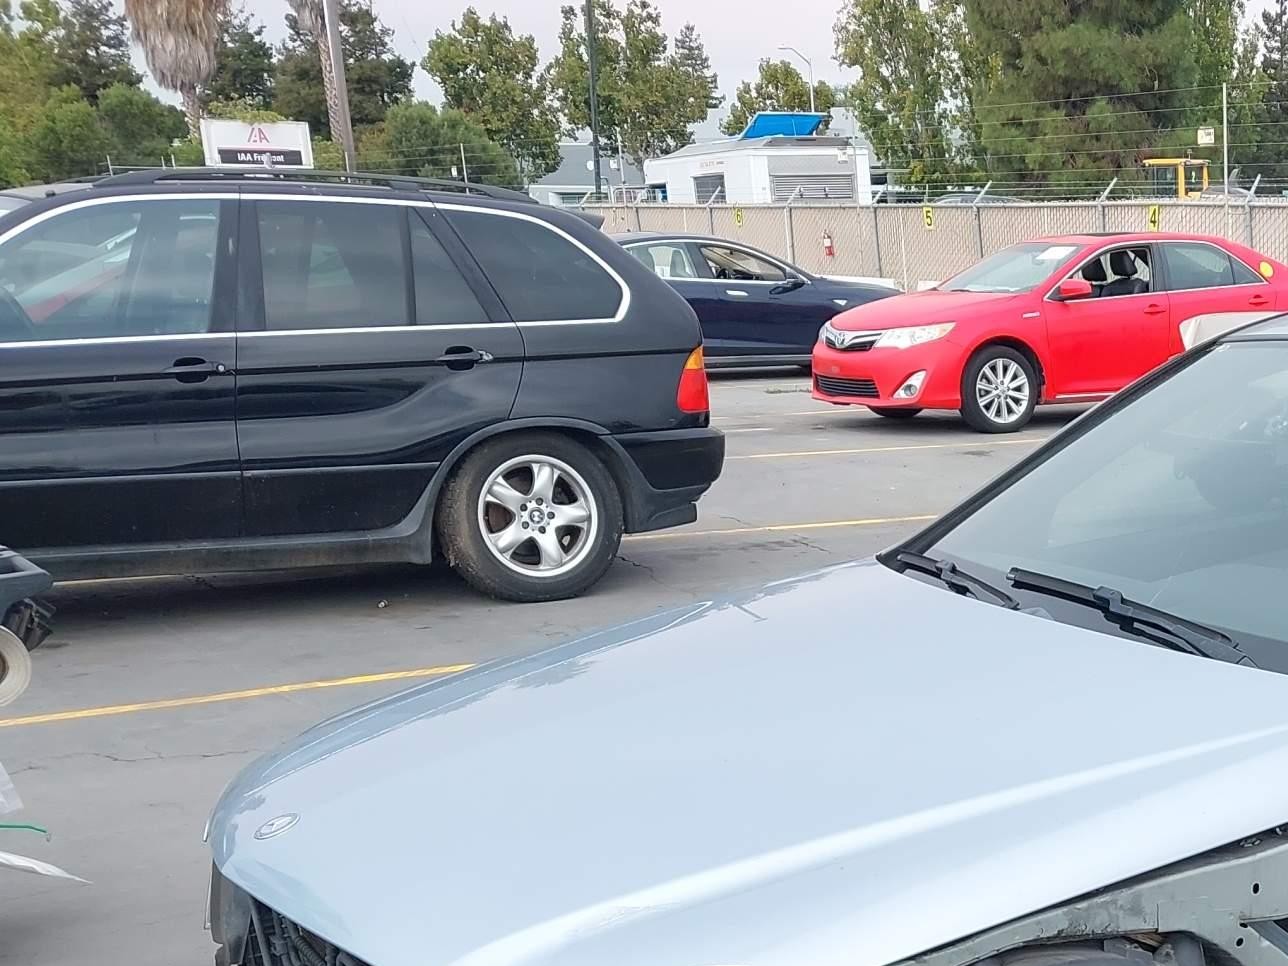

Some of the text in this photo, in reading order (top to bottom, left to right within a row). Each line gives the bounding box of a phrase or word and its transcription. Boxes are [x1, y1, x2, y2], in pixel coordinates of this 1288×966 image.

[237, 152, 254, 162] IAA
[925, 209, 933, 226] 5
[1150, 207, 1157, 228] 4
